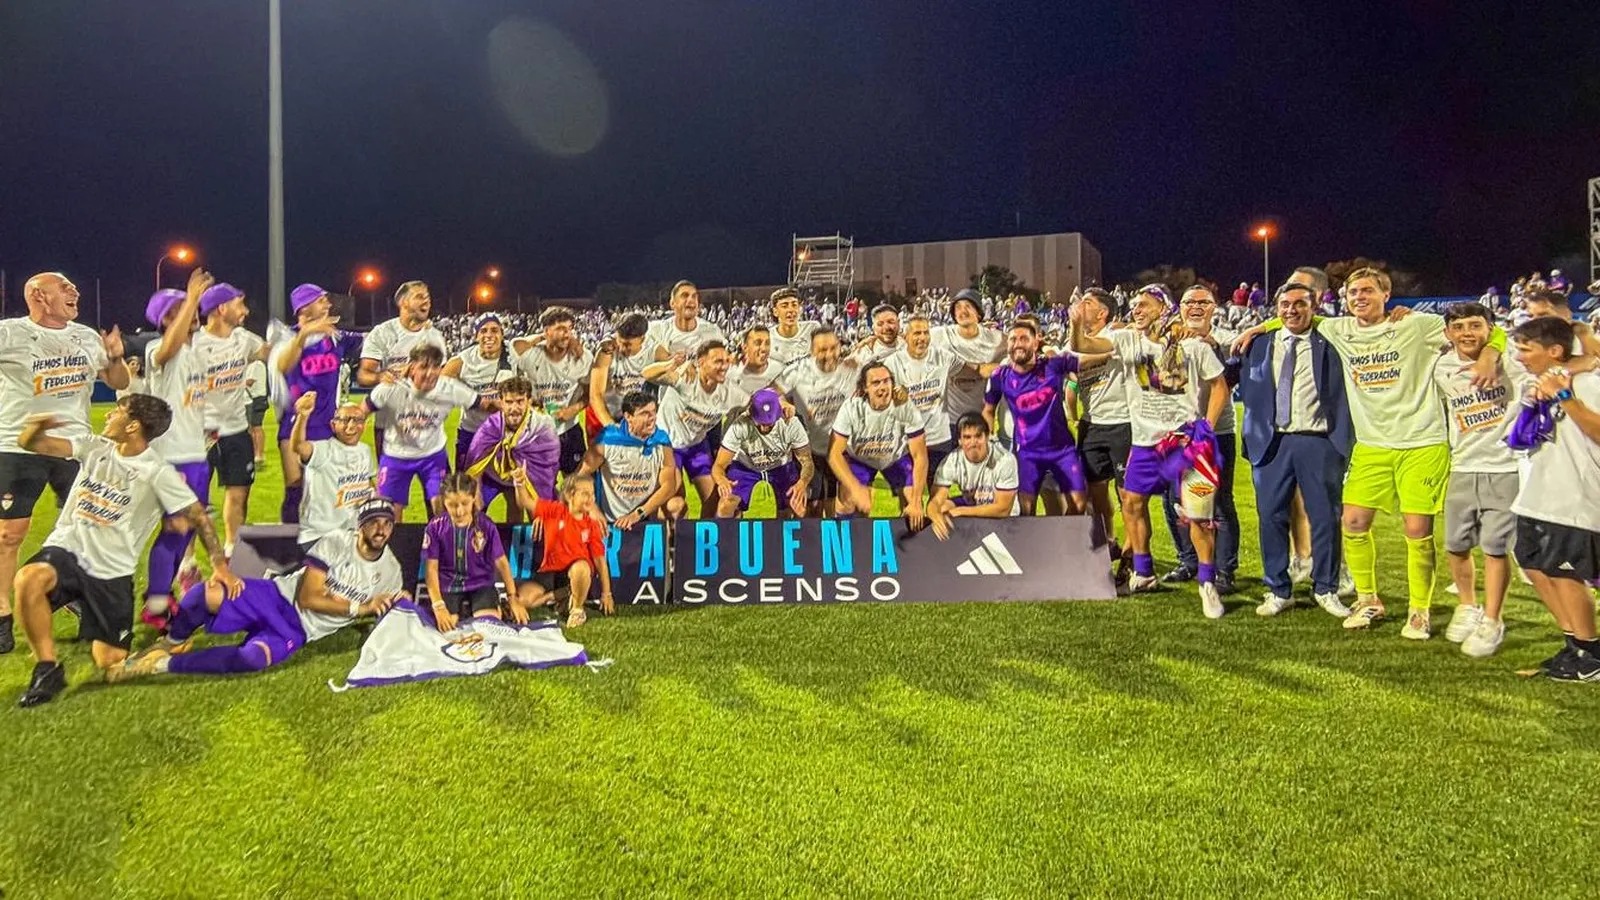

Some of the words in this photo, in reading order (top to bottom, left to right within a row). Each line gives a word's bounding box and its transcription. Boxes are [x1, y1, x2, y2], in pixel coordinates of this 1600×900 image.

[32, 357, 62, 373] HEMOS
[1371, 350, 1400, 364] VUELTO
[1475, 385, 1506, 403] VUELTO
[632, 577, 900, 604] ASCENSO
